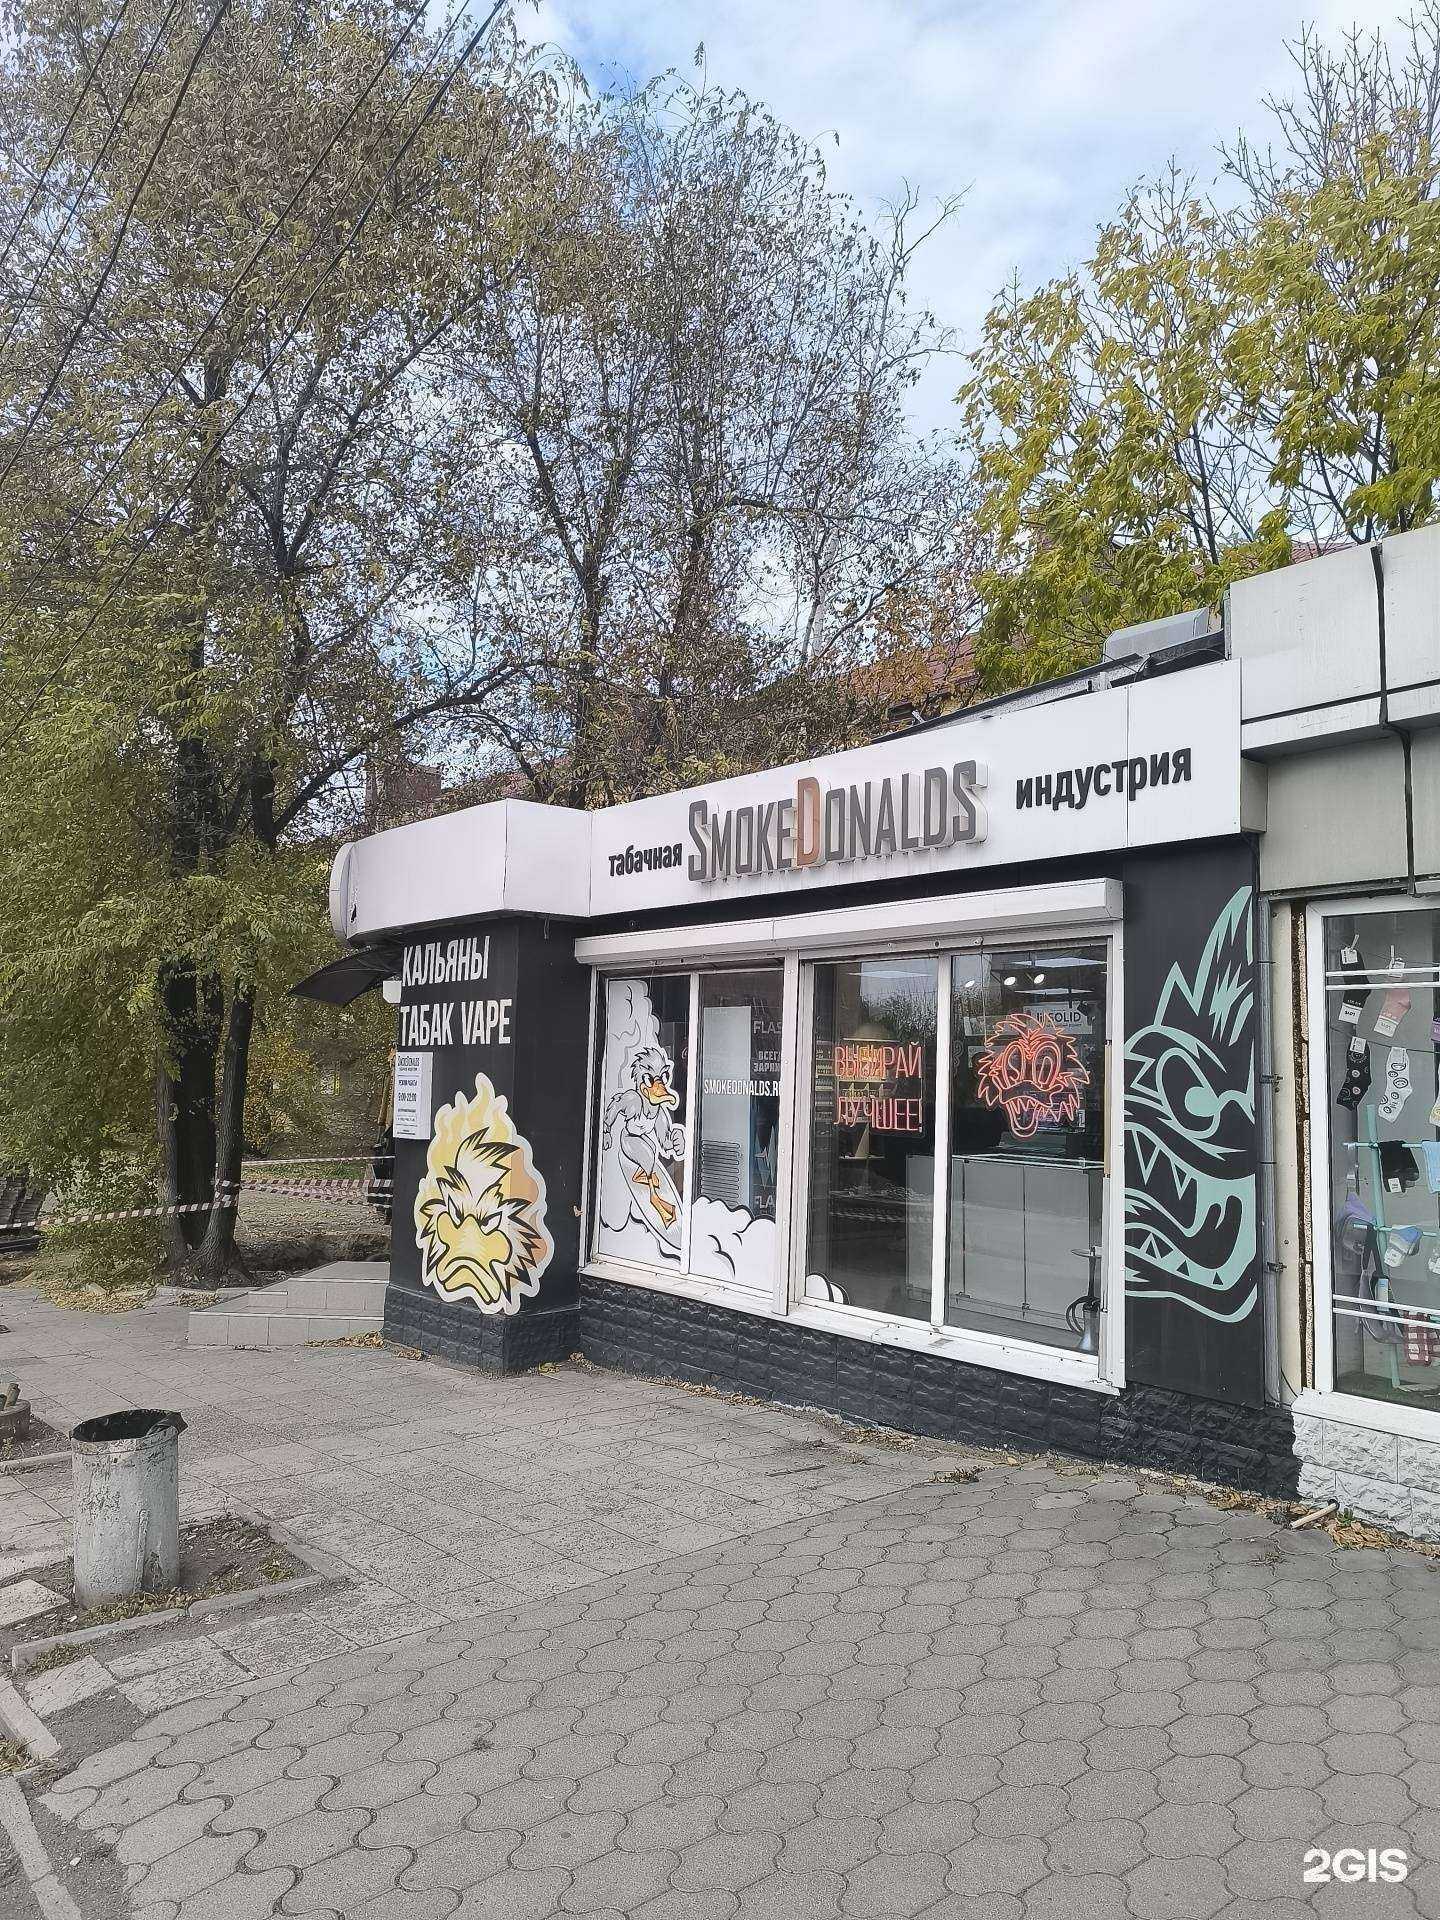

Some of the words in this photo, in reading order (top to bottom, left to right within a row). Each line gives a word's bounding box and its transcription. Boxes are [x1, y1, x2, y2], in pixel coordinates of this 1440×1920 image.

[1016, 747, 1192, 811] индустрия
[608, 843, 683, 877] табачная
[402, 936, 491, 987] КАЛЬЯНЫ
[400, 1002, 454, 1047] ТАБАК
[461, 998, 513, 1046] VAPE
[758, 1050, 780, 1061] ВСЕГ
[834, 1041, 922, 1080] ВЫБИРАЙ
[833, 1095, 922, 1133] ЛУЧШЕЕ!
